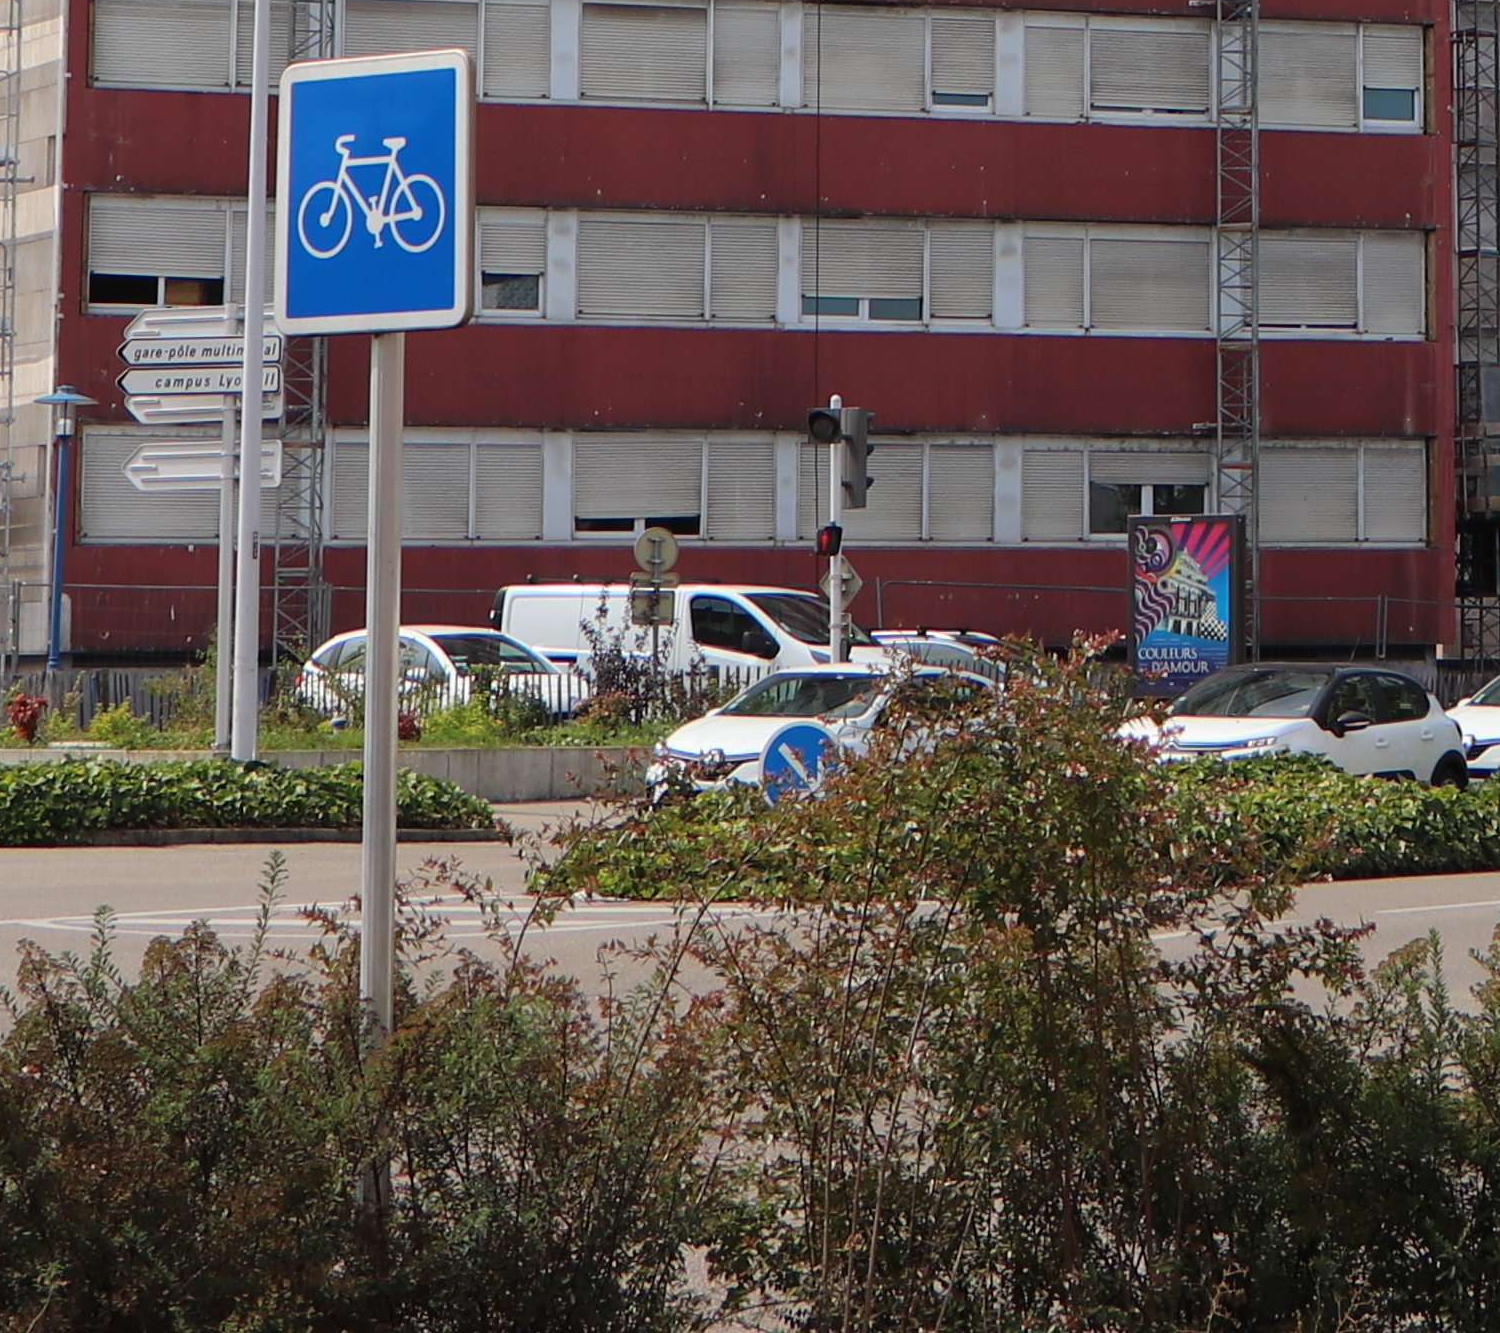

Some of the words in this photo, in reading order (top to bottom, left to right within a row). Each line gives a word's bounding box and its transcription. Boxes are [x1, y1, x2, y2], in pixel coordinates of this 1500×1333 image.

[133, 344, 197, 362] gare-pôle
[201, 342, 277, 358] multimal
[155, 378, 211, 391] campus
[218, 373, 243, 389] Lyo
[1137, 647, 1198, 660] COULEURS
[1152, 660, 1210, 674] D'AMOUR
